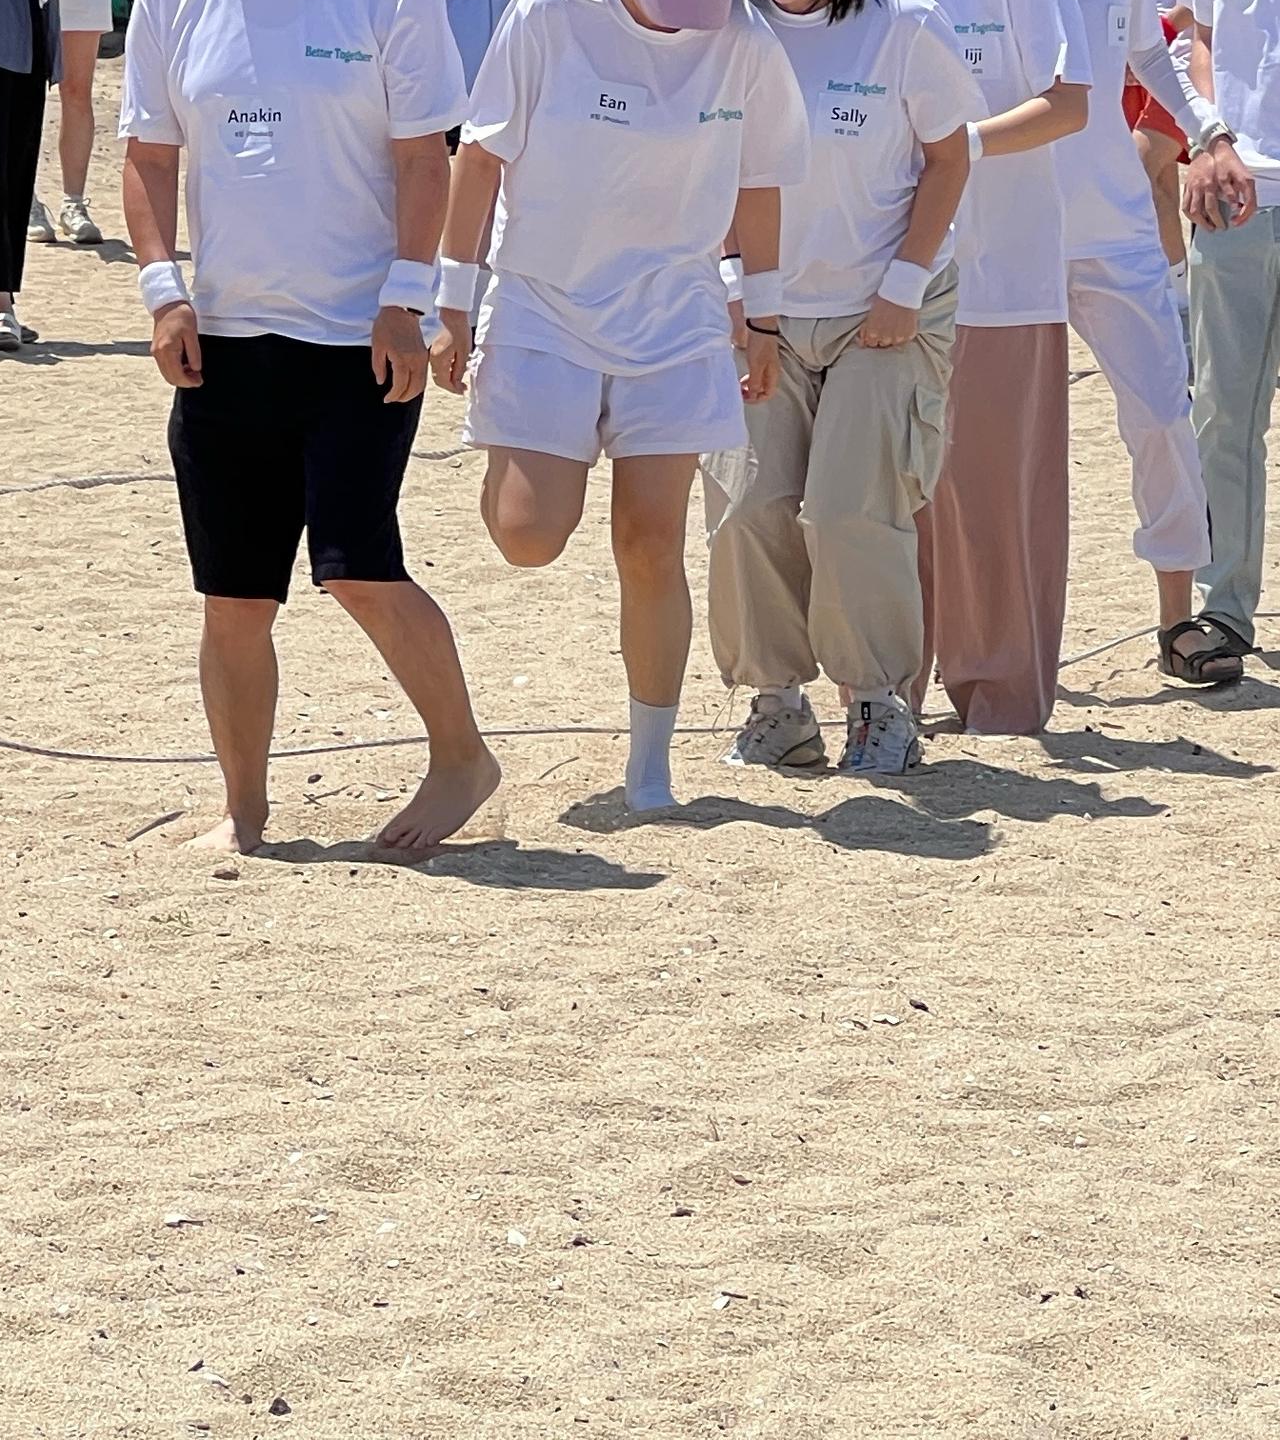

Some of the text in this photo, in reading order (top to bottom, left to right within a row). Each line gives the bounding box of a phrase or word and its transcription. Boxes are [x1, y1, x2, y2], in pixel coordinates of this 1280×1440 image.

[305, 45, 373, 63] Better Together
[827, 79, 887, 97] Better Together
[599, 93, 627, 111] Ean
[227, 107, 282, 123] Anakin
[831, 107, 868, 127] Sally
